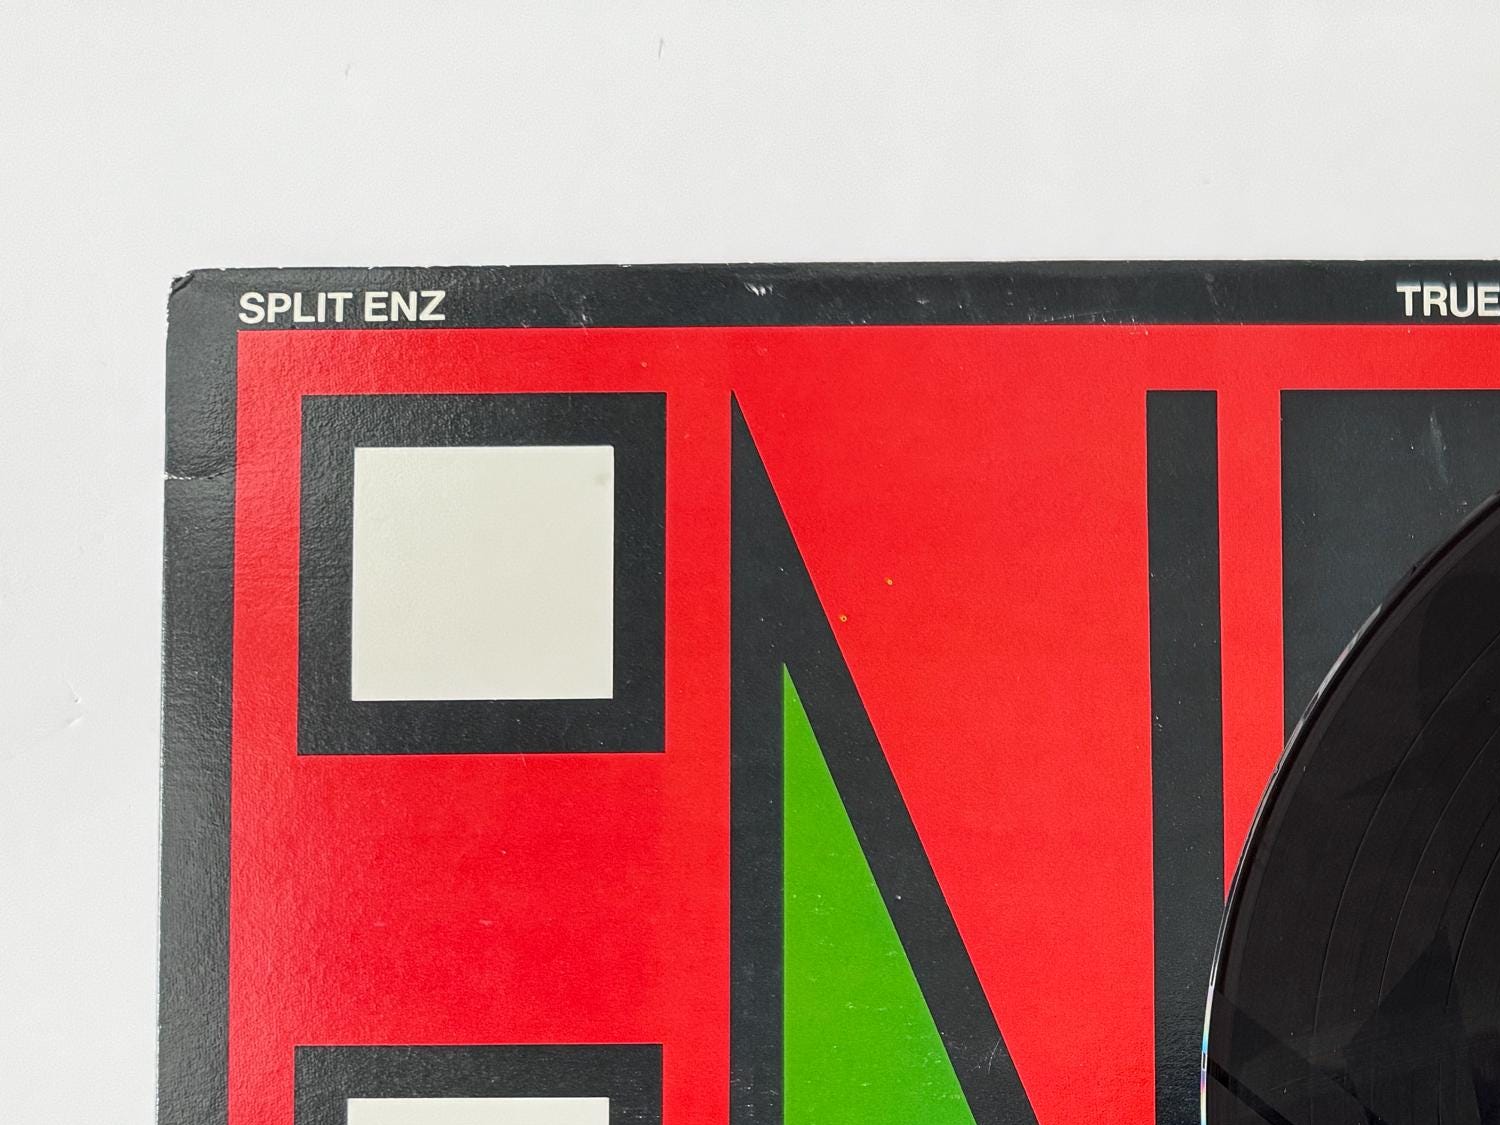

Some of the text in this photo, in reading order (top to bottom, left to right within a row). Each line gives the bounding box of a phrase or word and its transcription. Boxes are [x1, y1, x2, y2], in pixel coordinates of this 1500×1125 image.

[238, 290, 446, 324] SPLIT ENZ
[1397, 284, 1500, 317] TRUE
